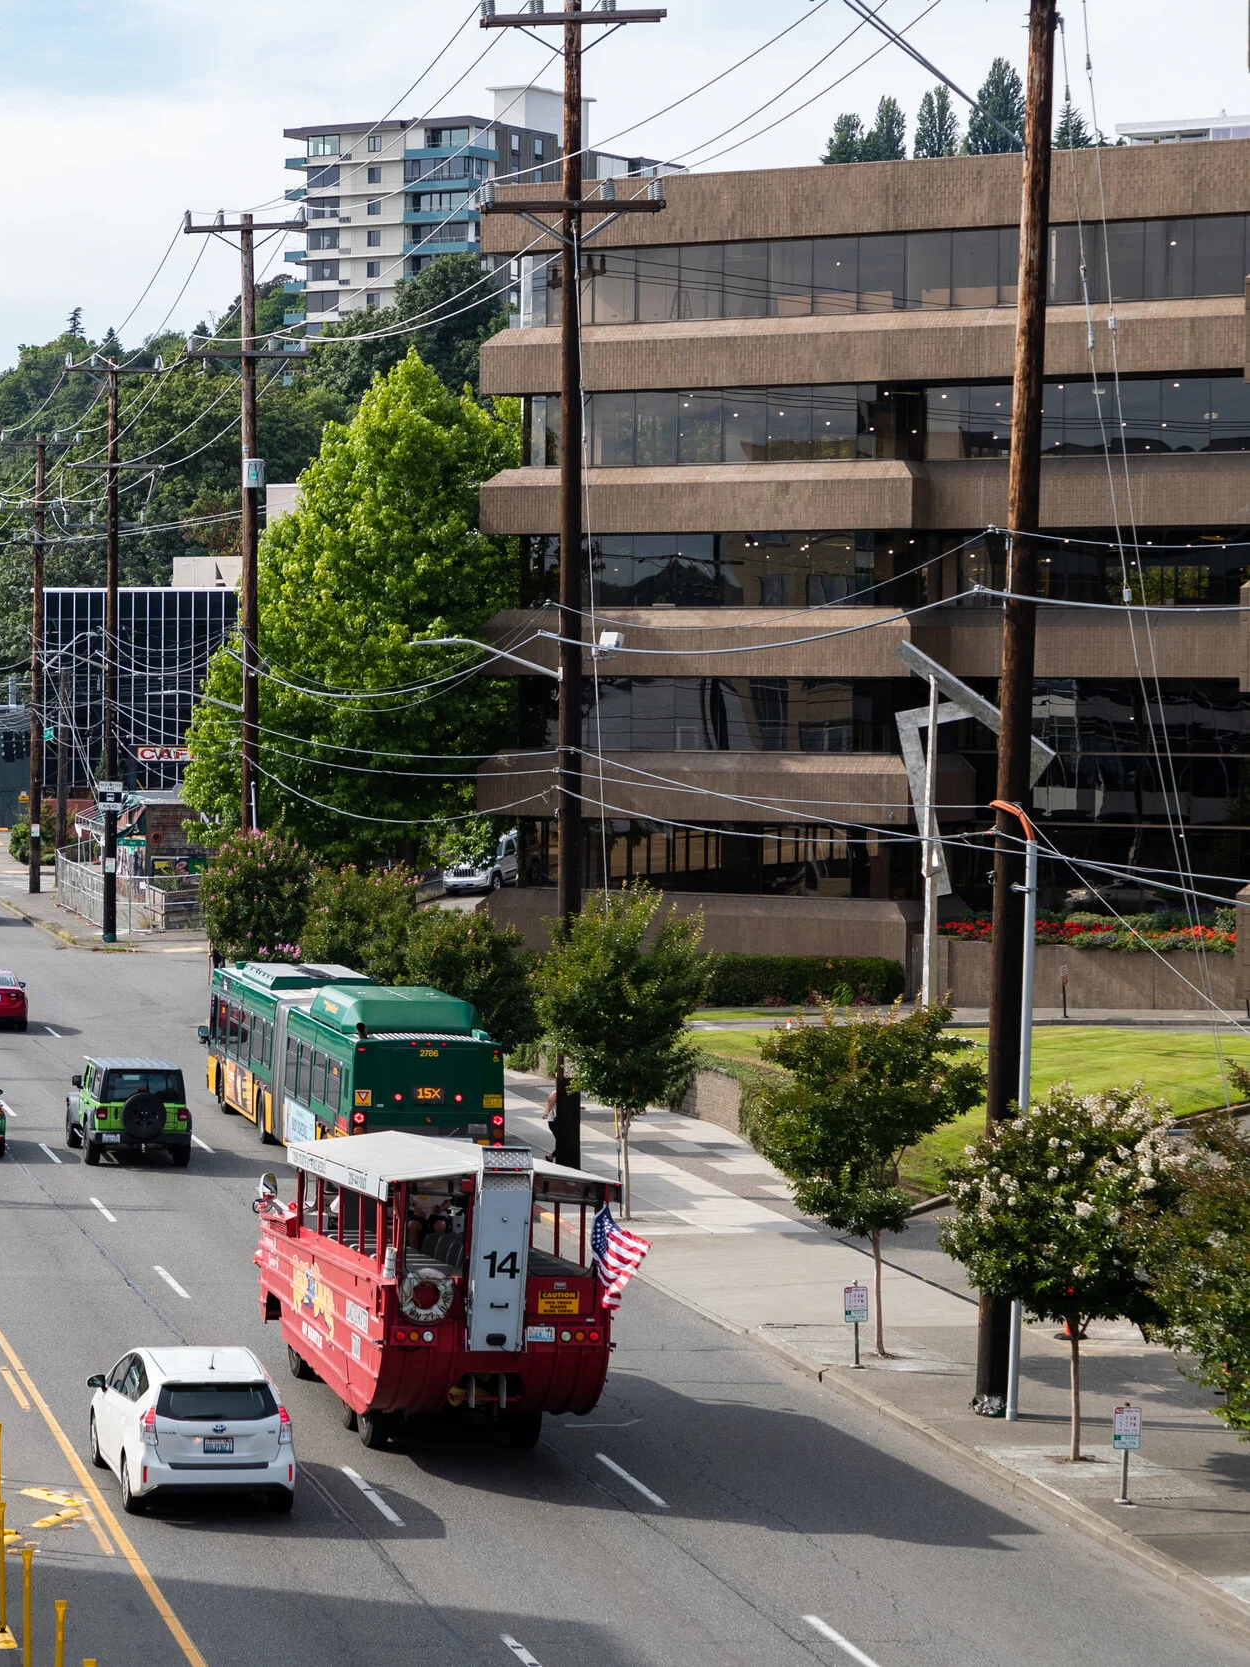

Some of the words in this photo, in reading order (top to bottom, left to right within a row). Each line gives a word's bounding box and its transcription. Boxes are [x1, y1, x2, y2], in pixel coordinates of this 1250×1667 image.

[419, 1049, 439, 1058] 2786
[417, 1087, 441, 1100] 15X
[483, 1251, 520, 1279] 14
